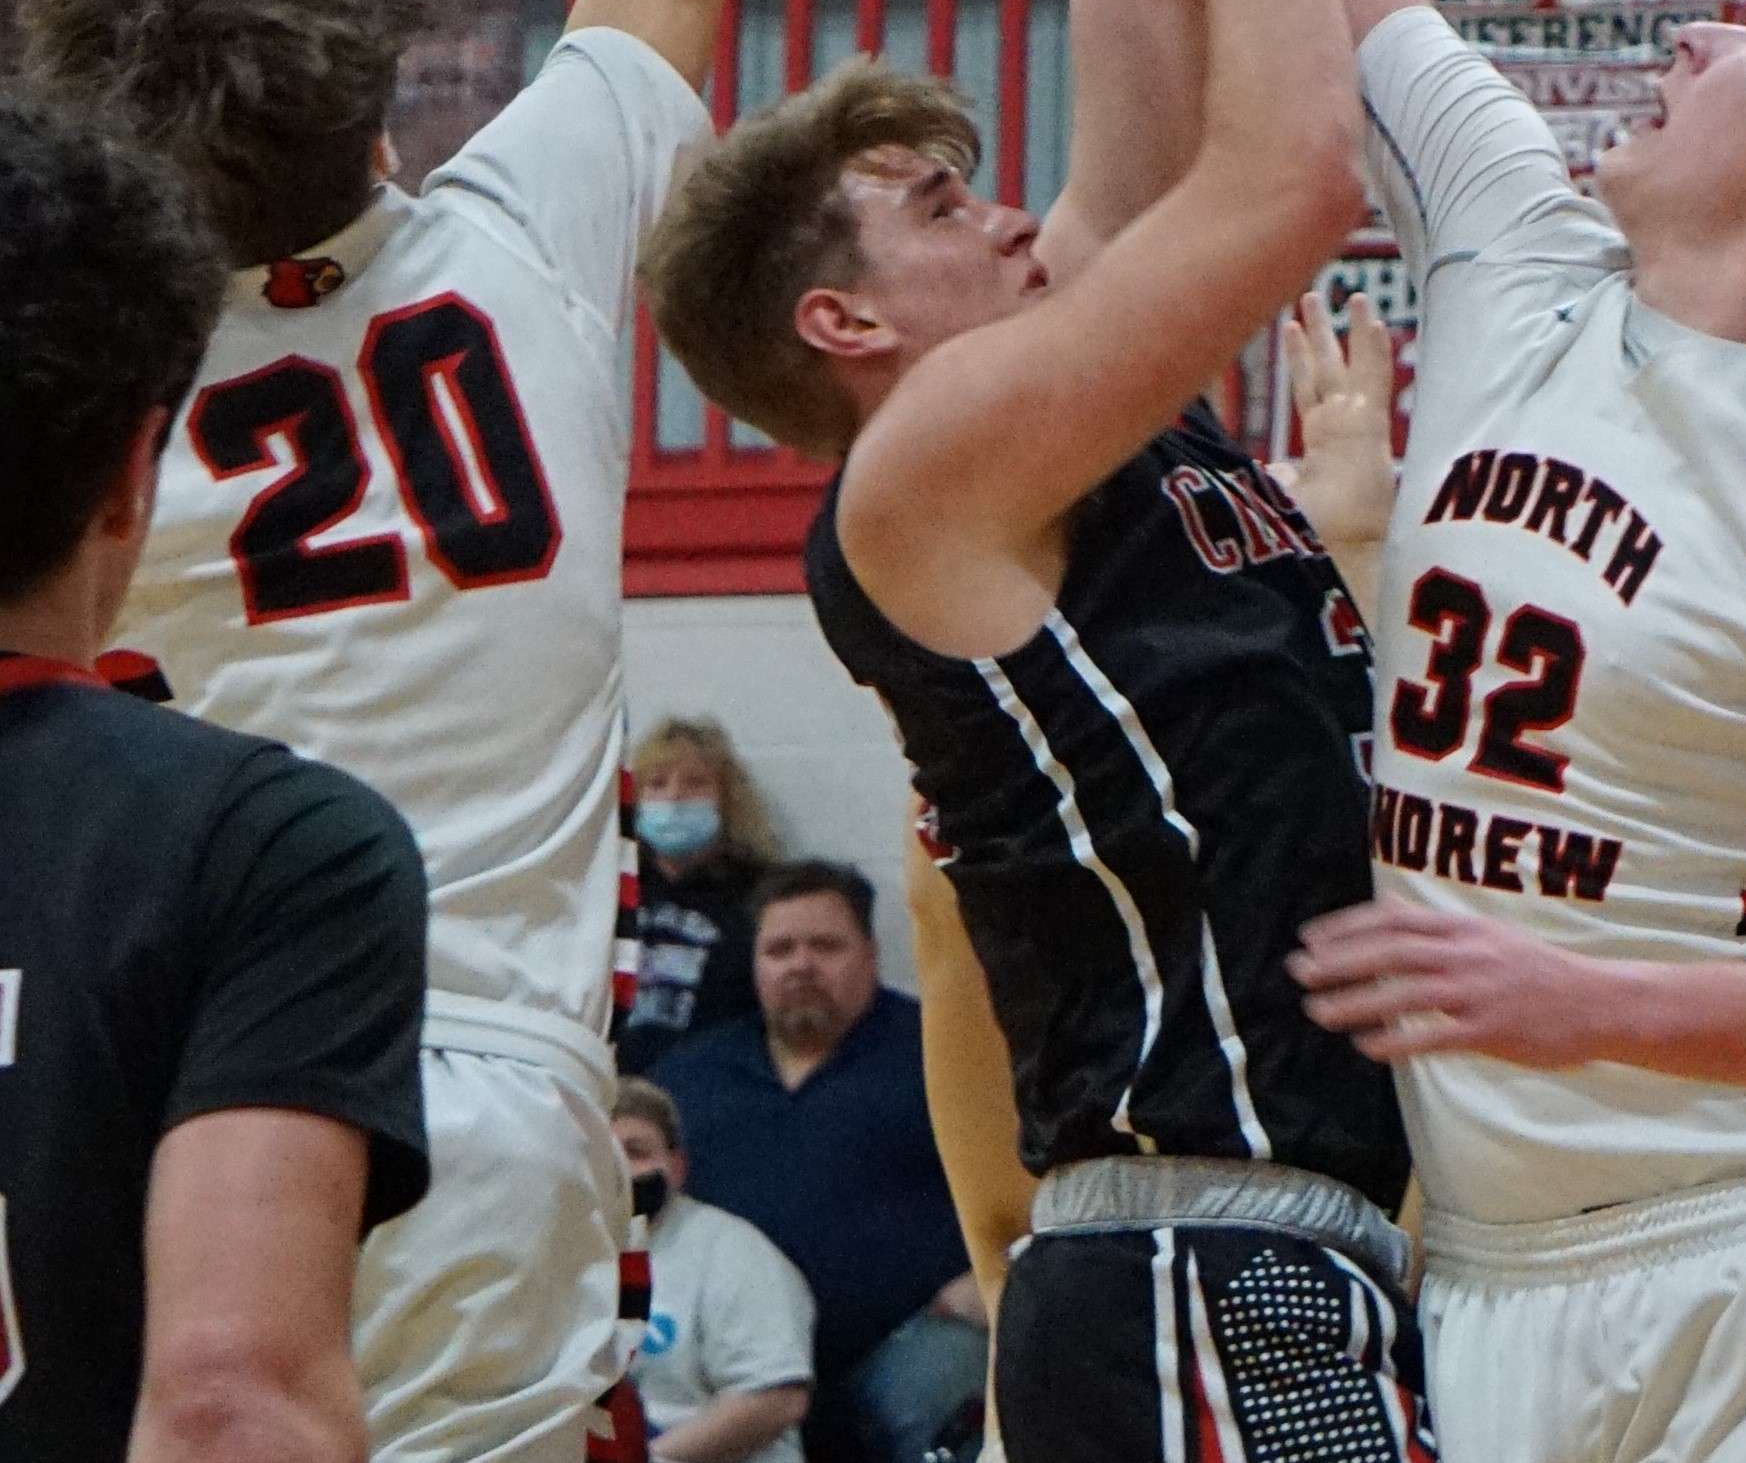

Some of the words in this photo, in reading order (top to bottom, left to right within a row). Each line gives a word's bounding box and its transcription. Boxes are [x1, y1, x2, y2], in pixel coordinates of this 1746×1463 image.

[186, 289, 565, 626] 20
[1421, 448, 1667, 609] NORTH
[1389, 564, 1587, 796] 32
[1373, 782, 1622, 903] NDREW
